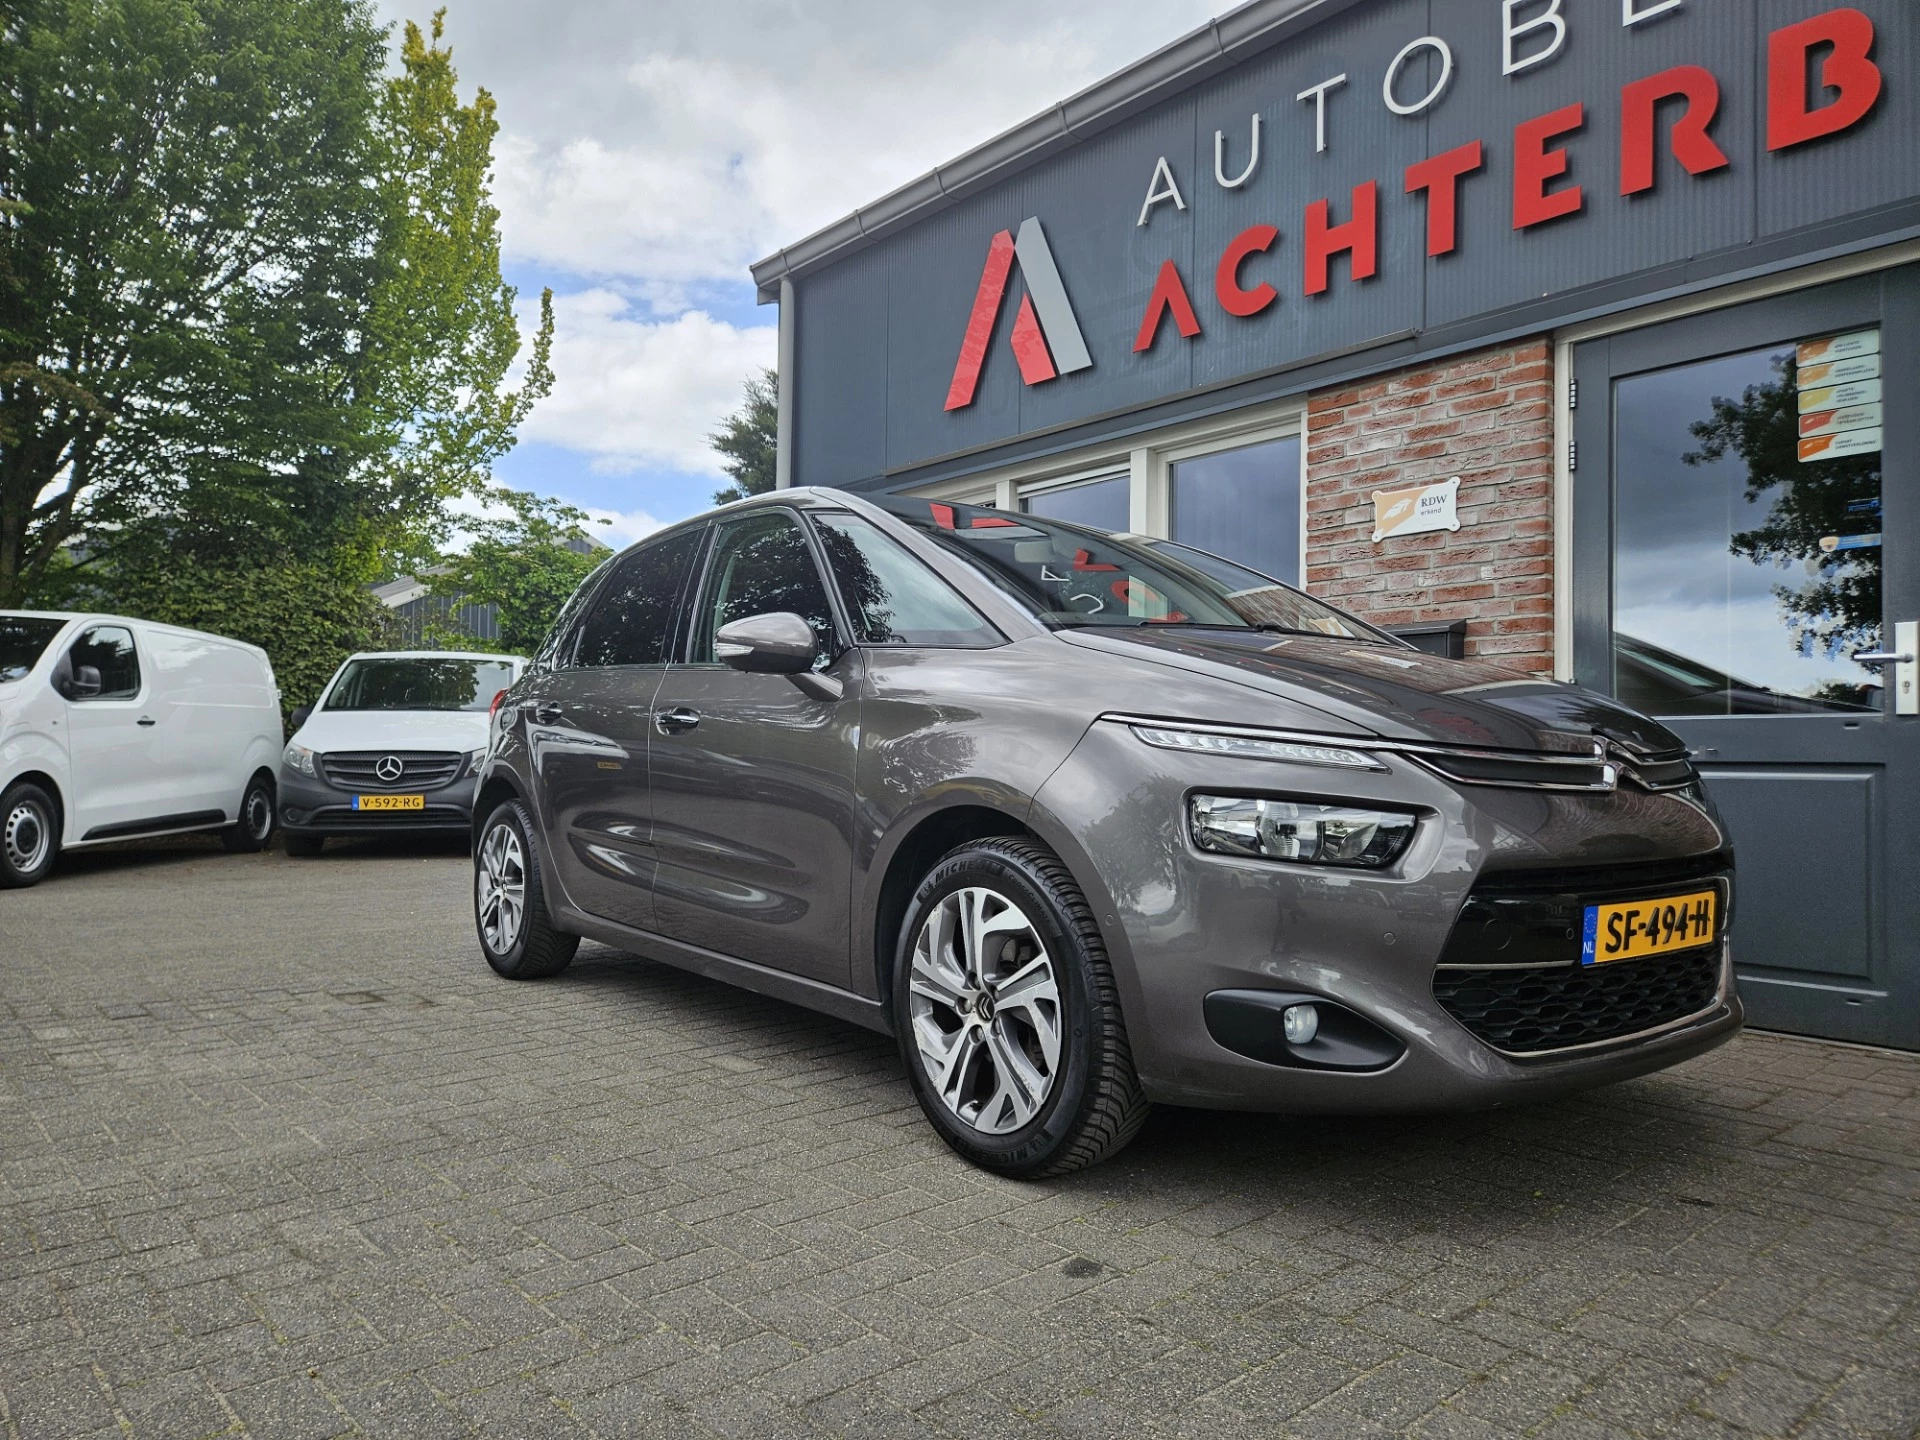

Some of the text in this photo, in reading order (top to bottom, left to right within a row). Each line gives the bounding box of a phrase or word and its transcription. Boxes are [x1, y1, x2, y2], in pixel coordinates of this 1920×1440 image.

[1137, 0, 1681, 228] AUTOB
[1132, 8, 1882, 353] ACHTERB
[1421, 494, 1447, 507] RDW
[362, 797, 420, 808] V-592-RG
[1605, 899, 1710, 954] SF-494-H
[1583, 941, 1594, 954] NL
